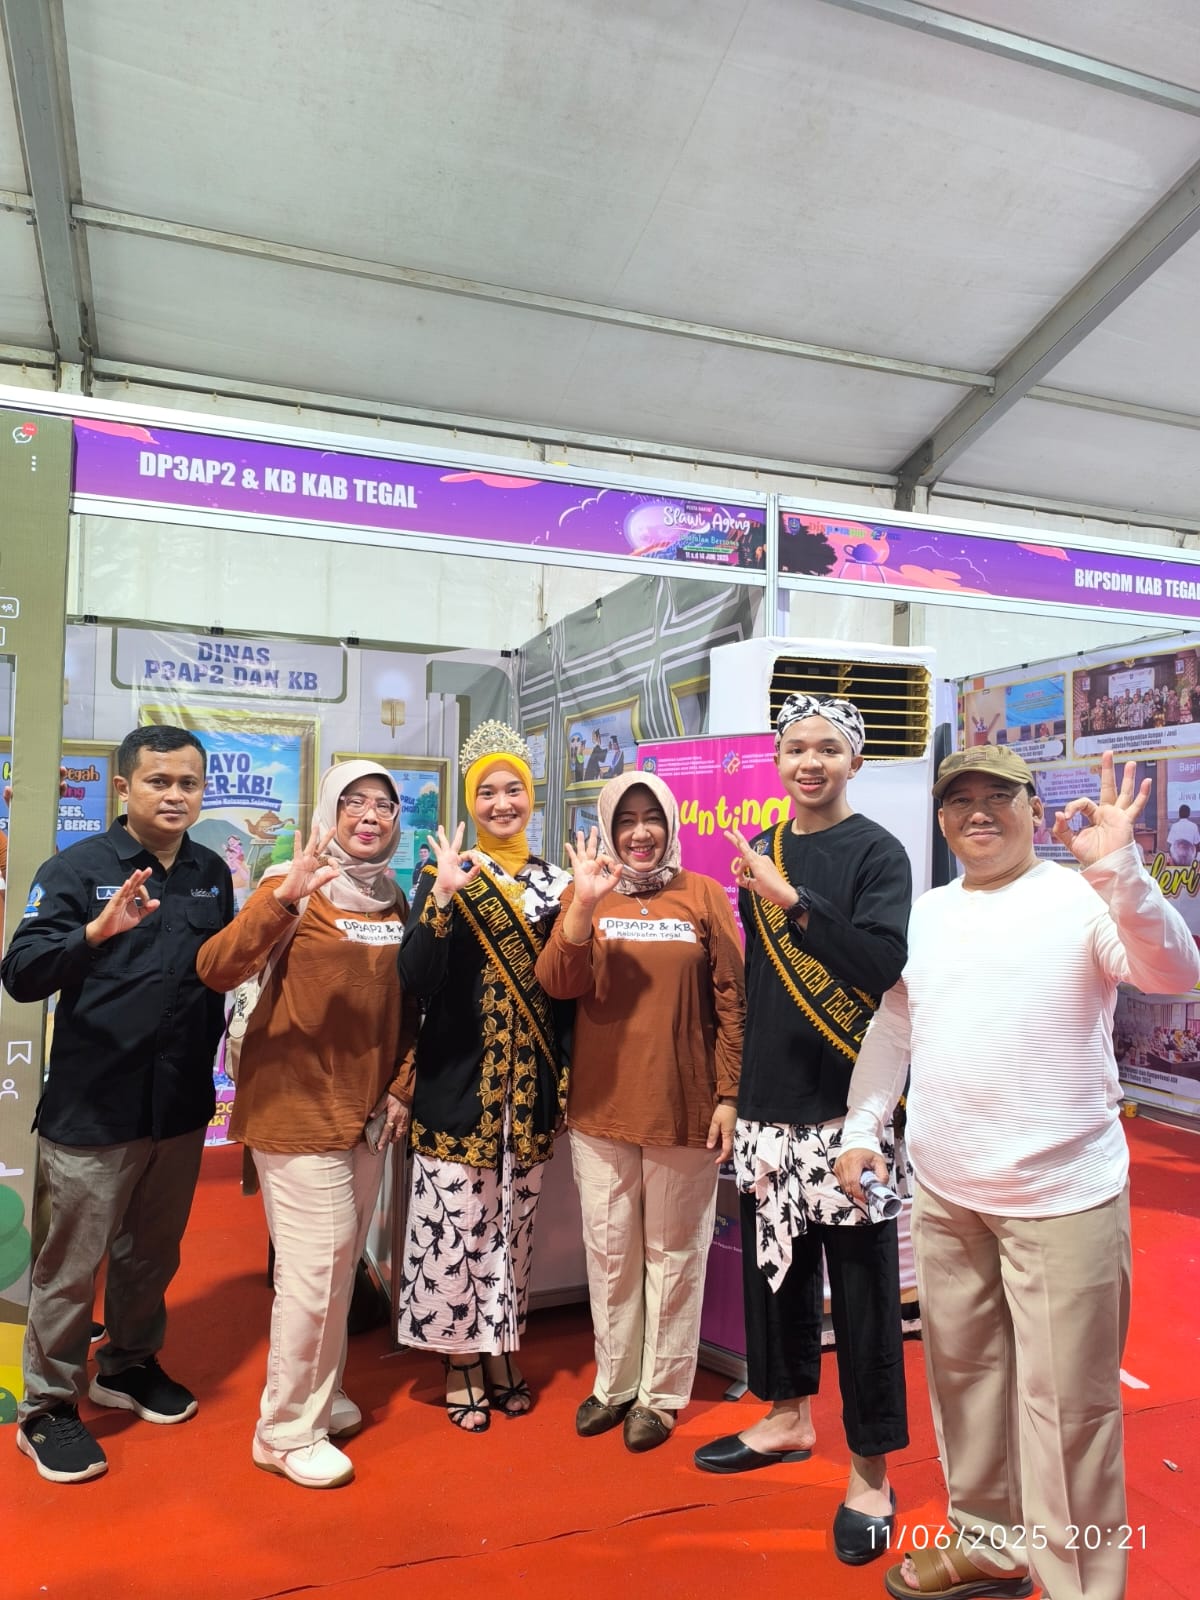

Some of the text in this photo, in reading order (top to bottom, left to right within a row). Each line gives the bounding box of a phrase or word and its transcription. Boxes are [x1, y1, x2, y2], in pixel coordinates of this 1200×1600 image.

[139, 451, 418, 509] DP3AP2 & KB KAB TEGAL
[663, 505, 751, 536] Slawi Ageng
[1074, 568, 1133, 593] BKPSDM
[1135, 575, 1163, 596] KAB
[198, 641, 270, 666] DINAS
[144, 659, 318, 691] P3AP2 DAN KB
[66, 765, 99, 783] egah
[209, 753, 250, 774] AYO
[204, 774, 273, 796] ER-KB!
[64, 819, 101, 831] BERES
[1151, 852, 1200, 896] leri
[463, 876, 490, 902] UTA
[477, 896, 512, 937] GENRE
[498, 930, 537, 993] KABUPATEN
[606, 919, 692, 932] DP3AP2 & KB
[616, 930, 681, 940] Kabupaten Tegal
[822, 987, 863, 1032] TEGAL
